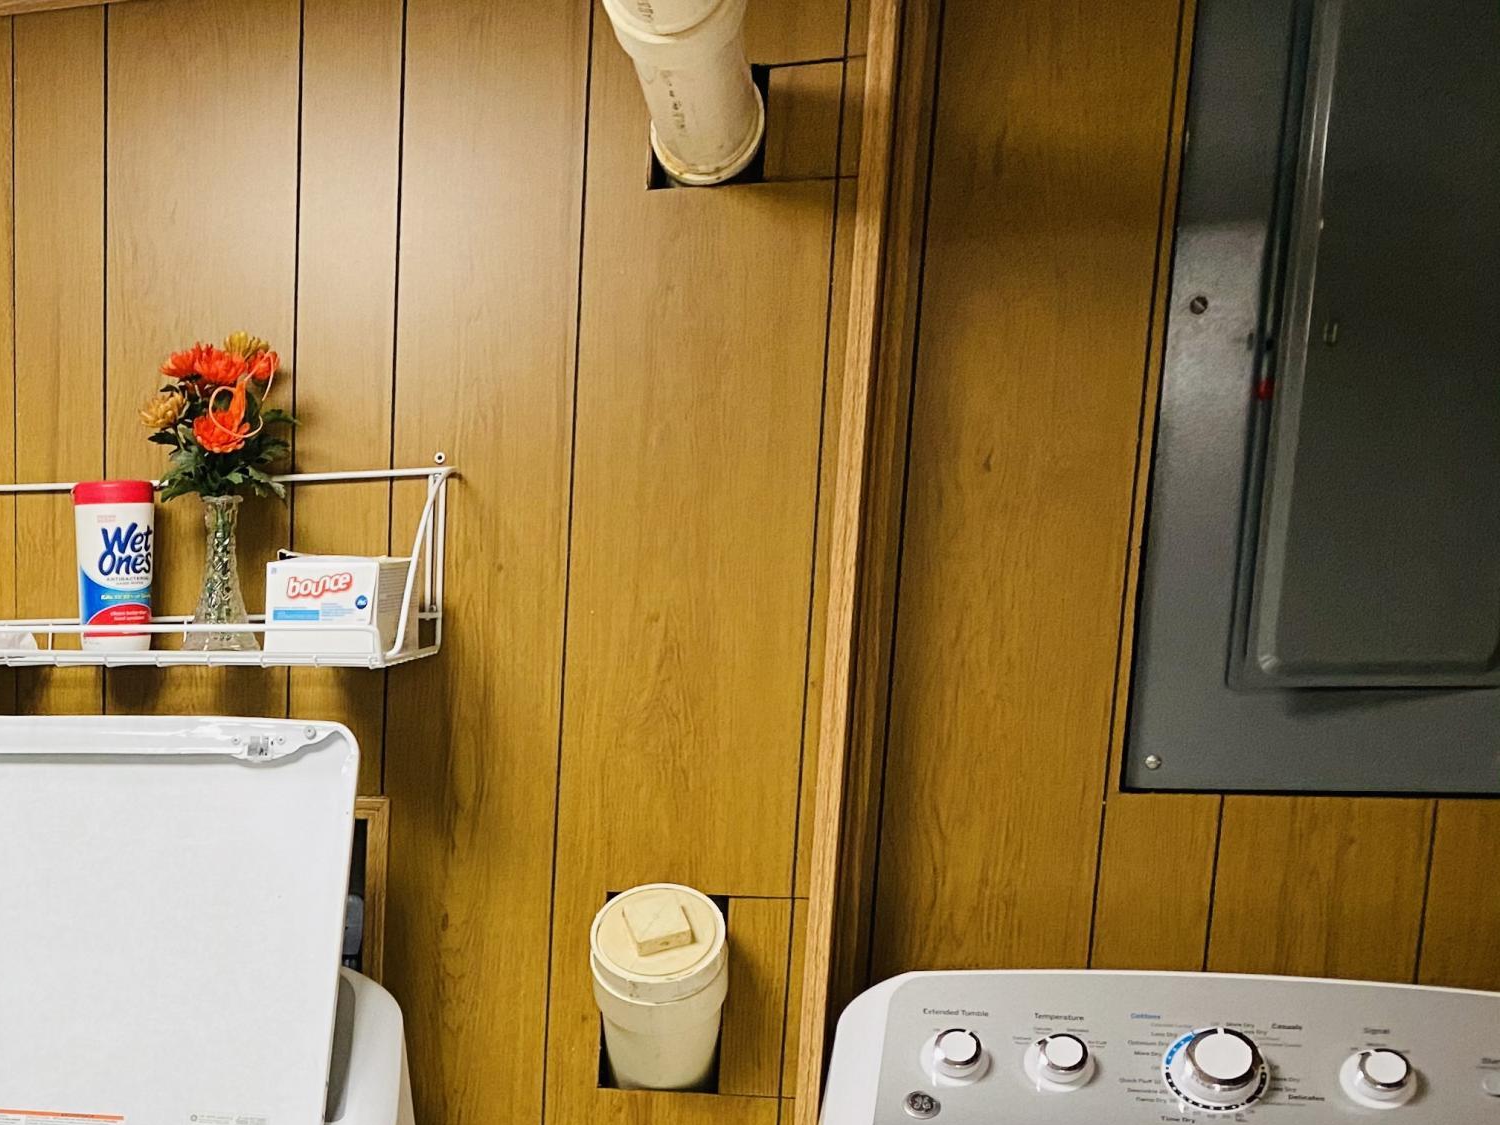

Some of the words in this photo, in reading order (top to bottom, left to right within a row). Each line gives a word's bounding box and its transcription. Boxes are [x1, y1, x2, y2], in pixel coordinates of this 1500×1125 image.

[100, 522, 153, 554] Wet
[98, 551, 152, 576] Ones
[287, 573, 353, 599] bounce
[1035, 1012, 1085, 1021] Temperature
